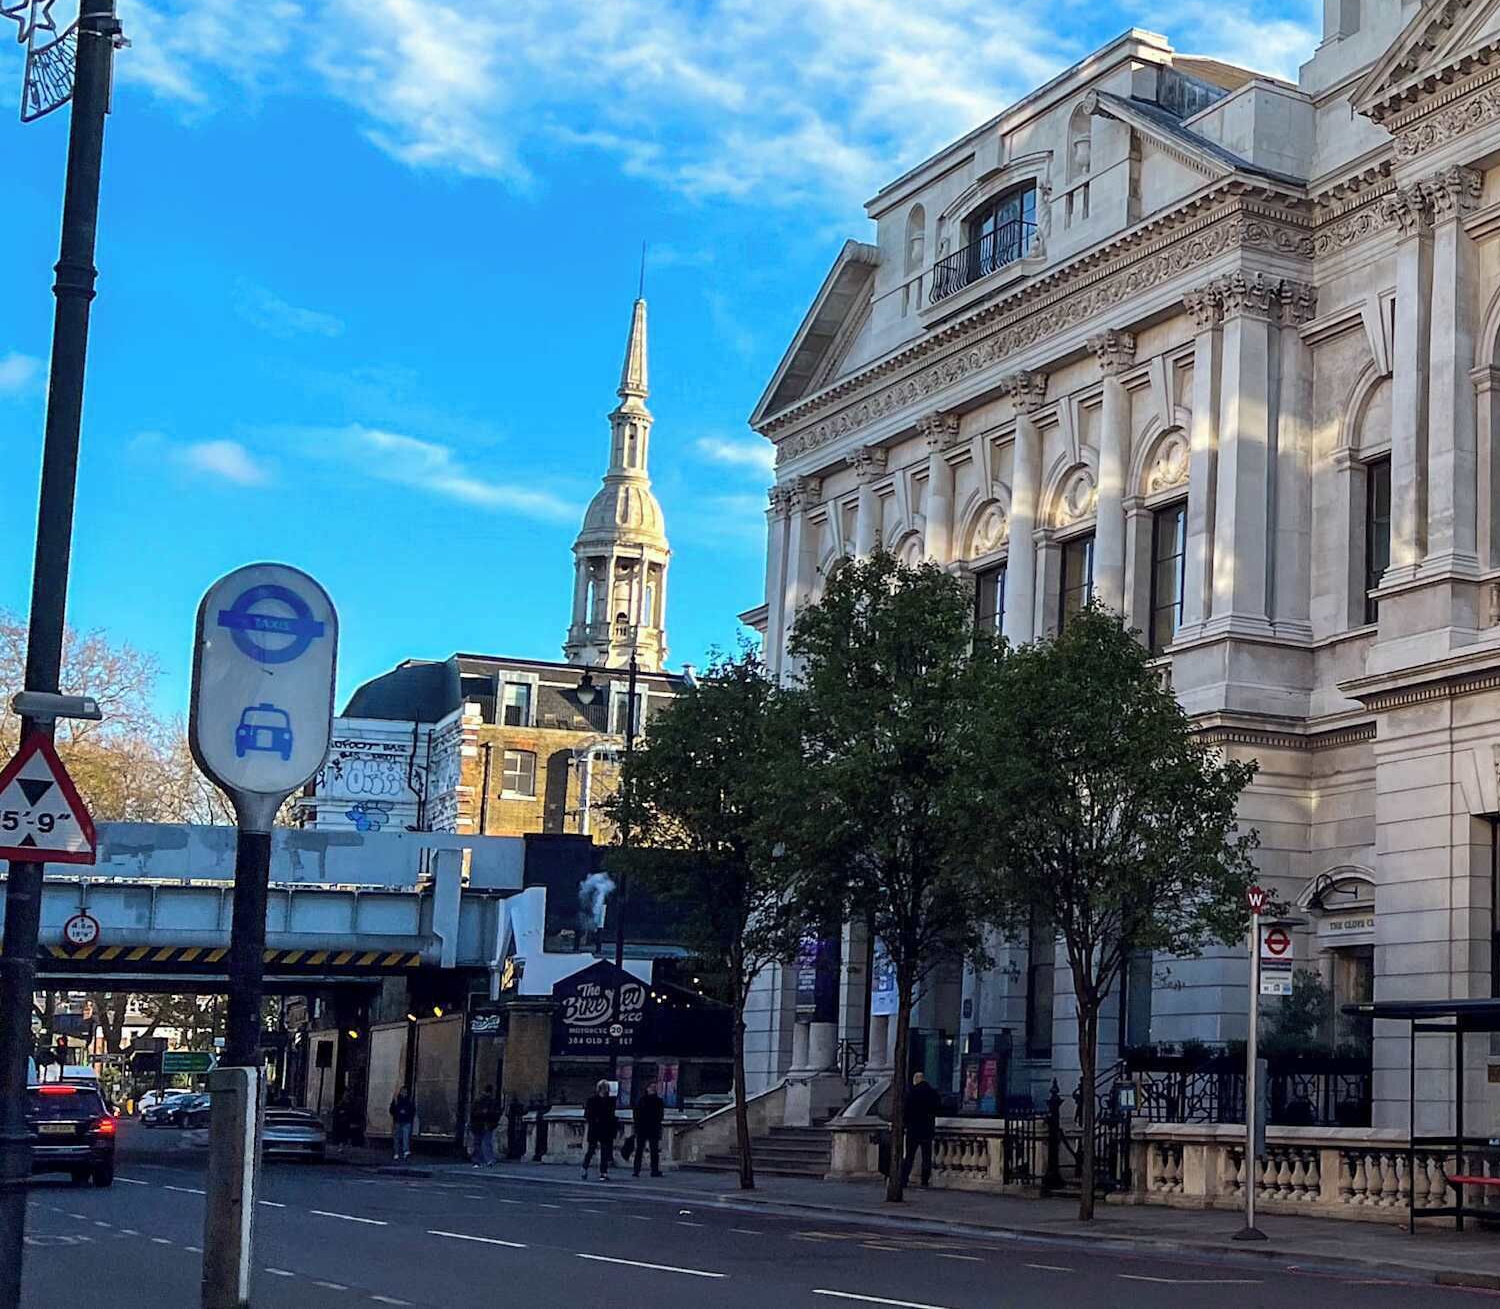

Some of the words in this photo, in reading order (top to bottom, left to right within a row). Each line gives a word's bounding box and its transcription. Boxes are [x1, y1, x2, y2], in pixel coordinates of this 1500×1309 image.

[255, 617, 290, 630] TAXIS
[1248, 893, 1263, 907] W
[611, 1026, 622, 1034] 20
